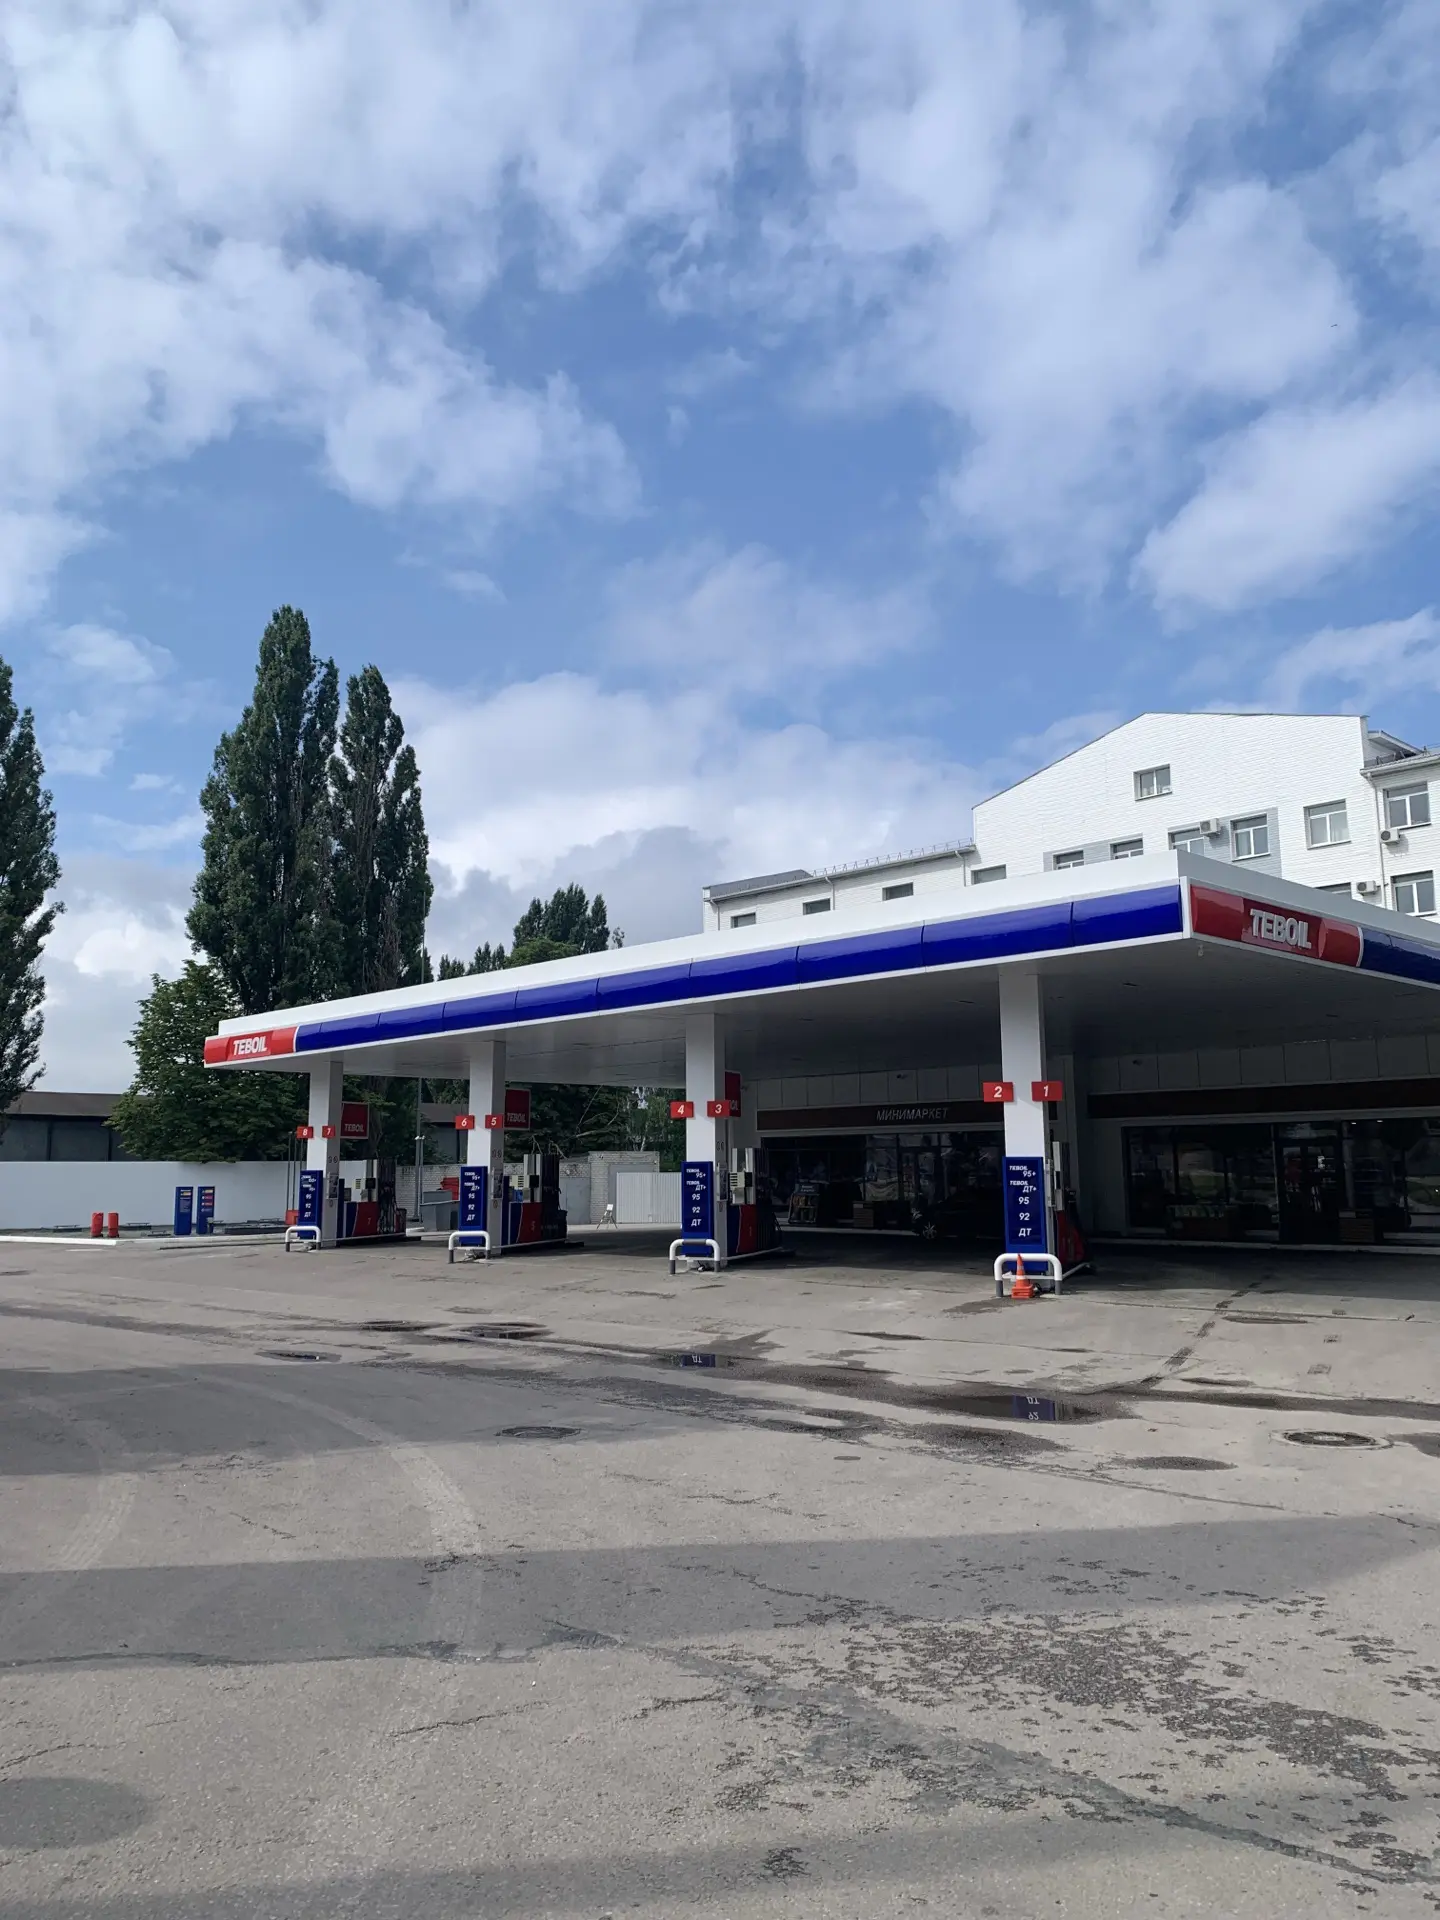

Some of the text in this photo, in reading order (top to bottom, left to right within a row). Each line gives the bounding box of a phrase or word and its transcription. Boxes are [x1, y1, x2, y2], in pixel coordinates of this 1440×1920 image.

[1249, 908, 1312, 949] TEBOIL
[233, 1036, 268, 1055] TEBOIL
[993, 1086, 1003, 1098] 2
[1043, 1086, 1049, 1097] 1
[677, 1105, 685, 1115] 4
[714, 1104, 722, 1114] 3
[506, 1112, 527, 1123] TEBOIL
[876, 1107, 949, 1121] МИНИМАРКЕТ
[461, 1117, 468, 1127] 6
[491, 1117, 497, 1126] 5
[302, 1128, 308, 1136] 8
[326, 1127, 332, 1136] 7
[344, 1124, 364, 1132] TEBOIL
[1022, 1170, 1037, 1178] 95+
[1022, 1185, 1037, 1193] ДТ+
[1018, 1197, 1030, 1205] 95
[1019, 1213, 1030, 1221] 92
[1018, 1228, 1032, 1237] ДТ
